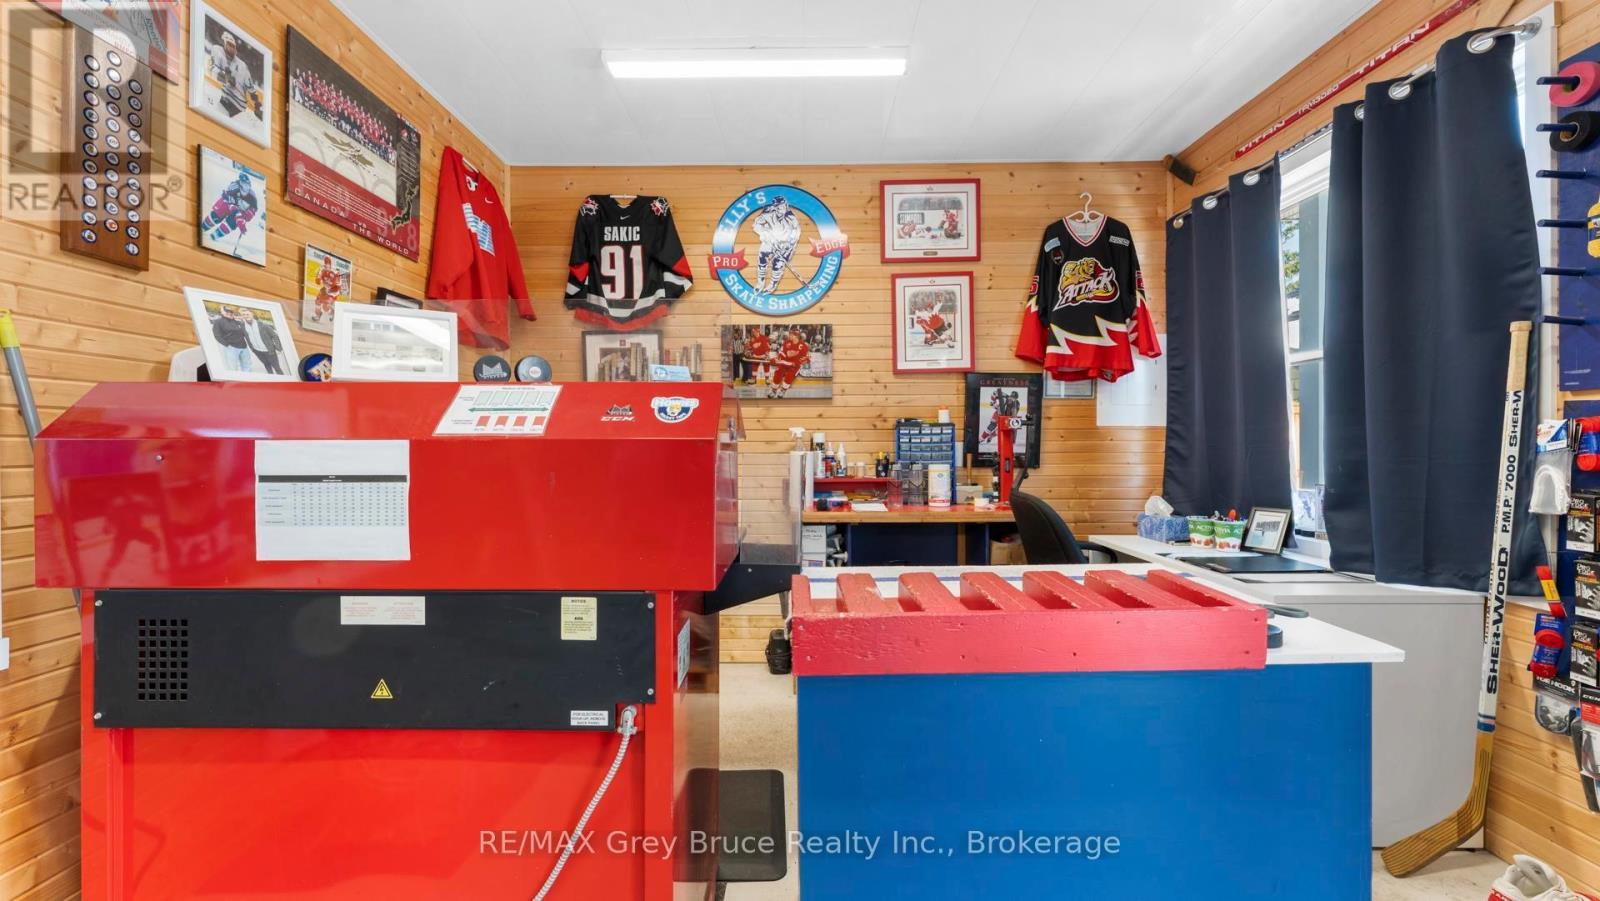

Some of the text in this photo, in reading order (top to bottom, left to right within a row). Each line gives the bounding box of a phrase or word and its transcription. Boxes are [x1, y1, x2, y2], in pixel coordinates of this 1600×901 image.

[1237, 119, 1286, 153] TITAN
[1355, 22, 1430, 74] TITAN
[294, 187, 346, 218] CANADA
[718, 191, 767, 233] LLY'S
[352, 222, 409, 255] THE WORLD
[603, 226, 641, 242] SAKIC
[814, 235, 846, 254] EDGE
[600, 244, 645, 301] 91
[712, 255, 739, 267] PRO
[725, 255, 839, 310] SKATE SHARPENING
[1061, 271, 1114, 304] ATTACK
[1486, 545, 1510, 695] SHER-WOOD
[1504, 454, 1517, 492] 7000
